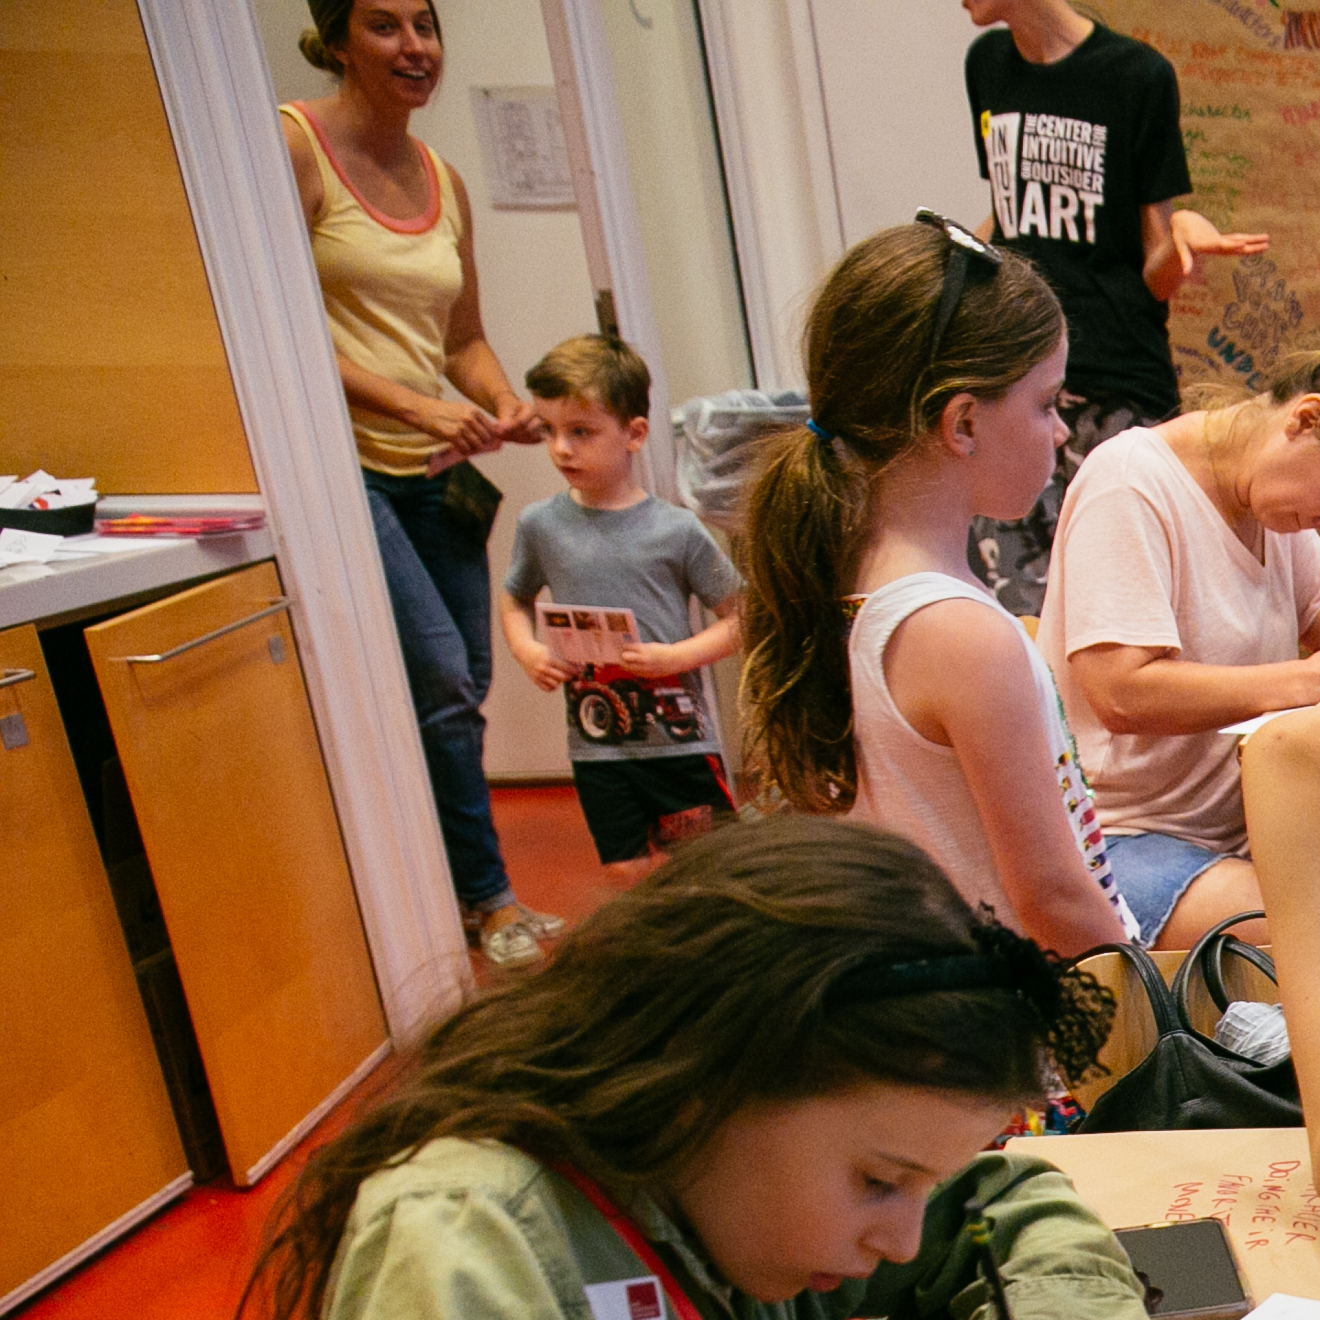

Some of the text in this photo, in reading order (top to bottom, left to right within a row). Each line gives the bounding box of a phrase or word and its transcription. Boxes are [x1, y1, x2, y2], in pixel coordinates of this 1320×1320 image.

[1036, 113, 1093, 144] CENTER
[1021, 134, 1105, 174] INTUITIVE
[1031, 161, 1105, 193] OUTSIDER
[1019, 180, 1105, 245] ART
